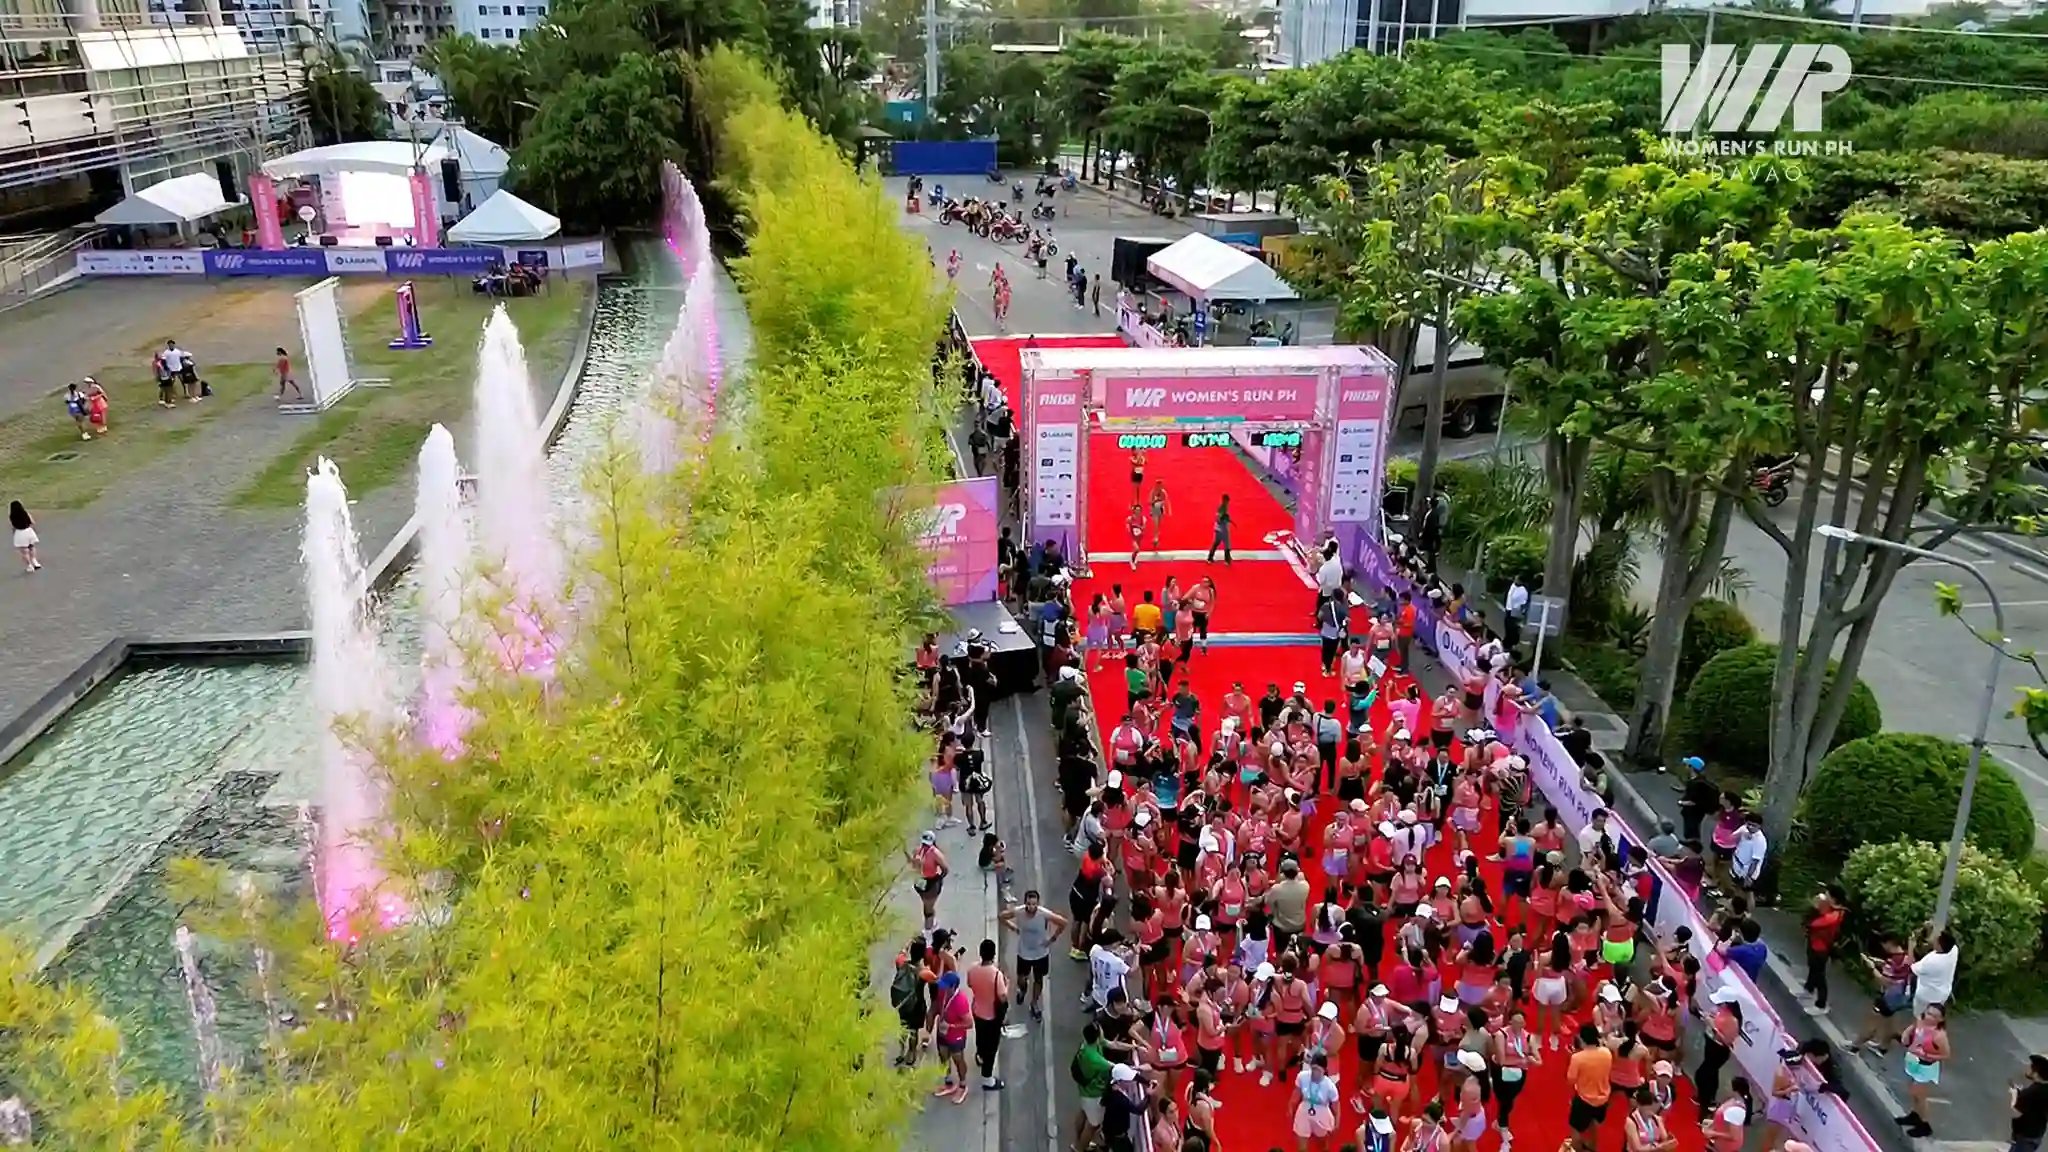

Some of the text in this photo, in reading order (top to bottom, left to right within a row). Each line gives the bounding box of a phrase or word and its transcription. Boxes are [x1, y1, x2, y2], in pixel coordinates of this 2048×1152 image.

[1039, 392, 1077, 406] FINISH
[1171, 389, 1239, 404] WOMEN'S
[1243, 389, 1274, 403] RUN
[1276, 389, 1298, 402] PH
[1343, 389, 1381, 403] FINISH
[1558, 775, 1575, 807] RUN
[1577, 799, 1589, 825] PH
